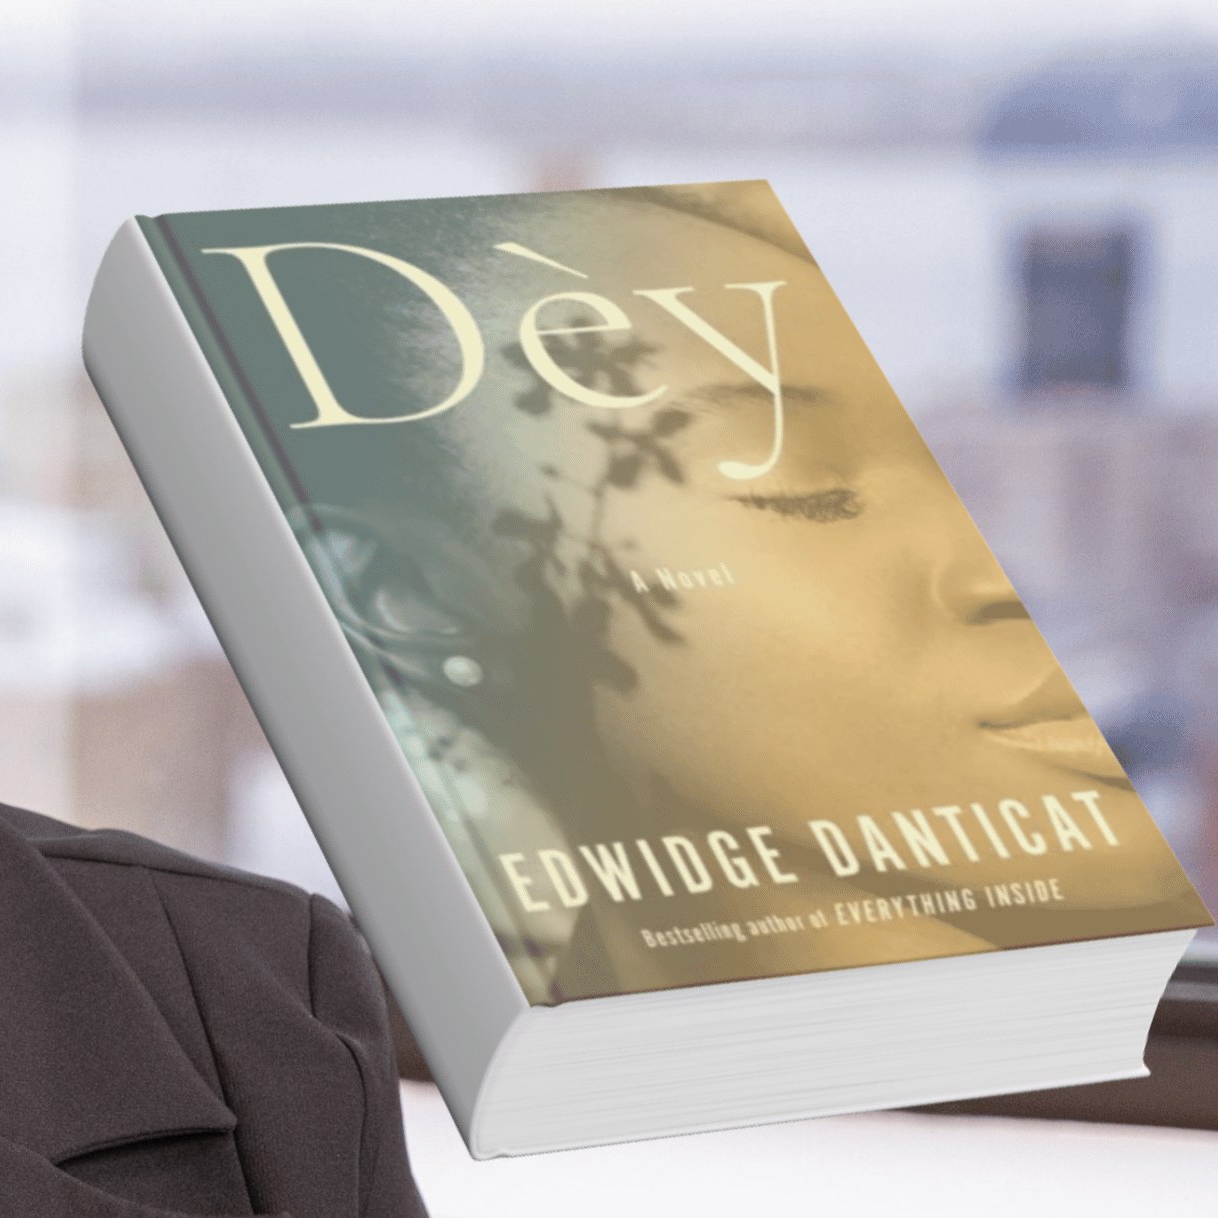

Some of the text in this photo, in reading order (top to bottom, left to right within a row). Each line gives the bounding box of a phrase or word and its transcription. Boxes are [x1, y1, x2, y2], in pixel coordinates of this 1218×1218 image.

[202, 240, 787, 481] Dèy
[630, 561, 735, 593] A Novel
[500, 790, 1121, 913] EDWIDGE DANTICAT
[641, 878, 1065, 948] Bestselling author of EVERYTHING INSIDE
